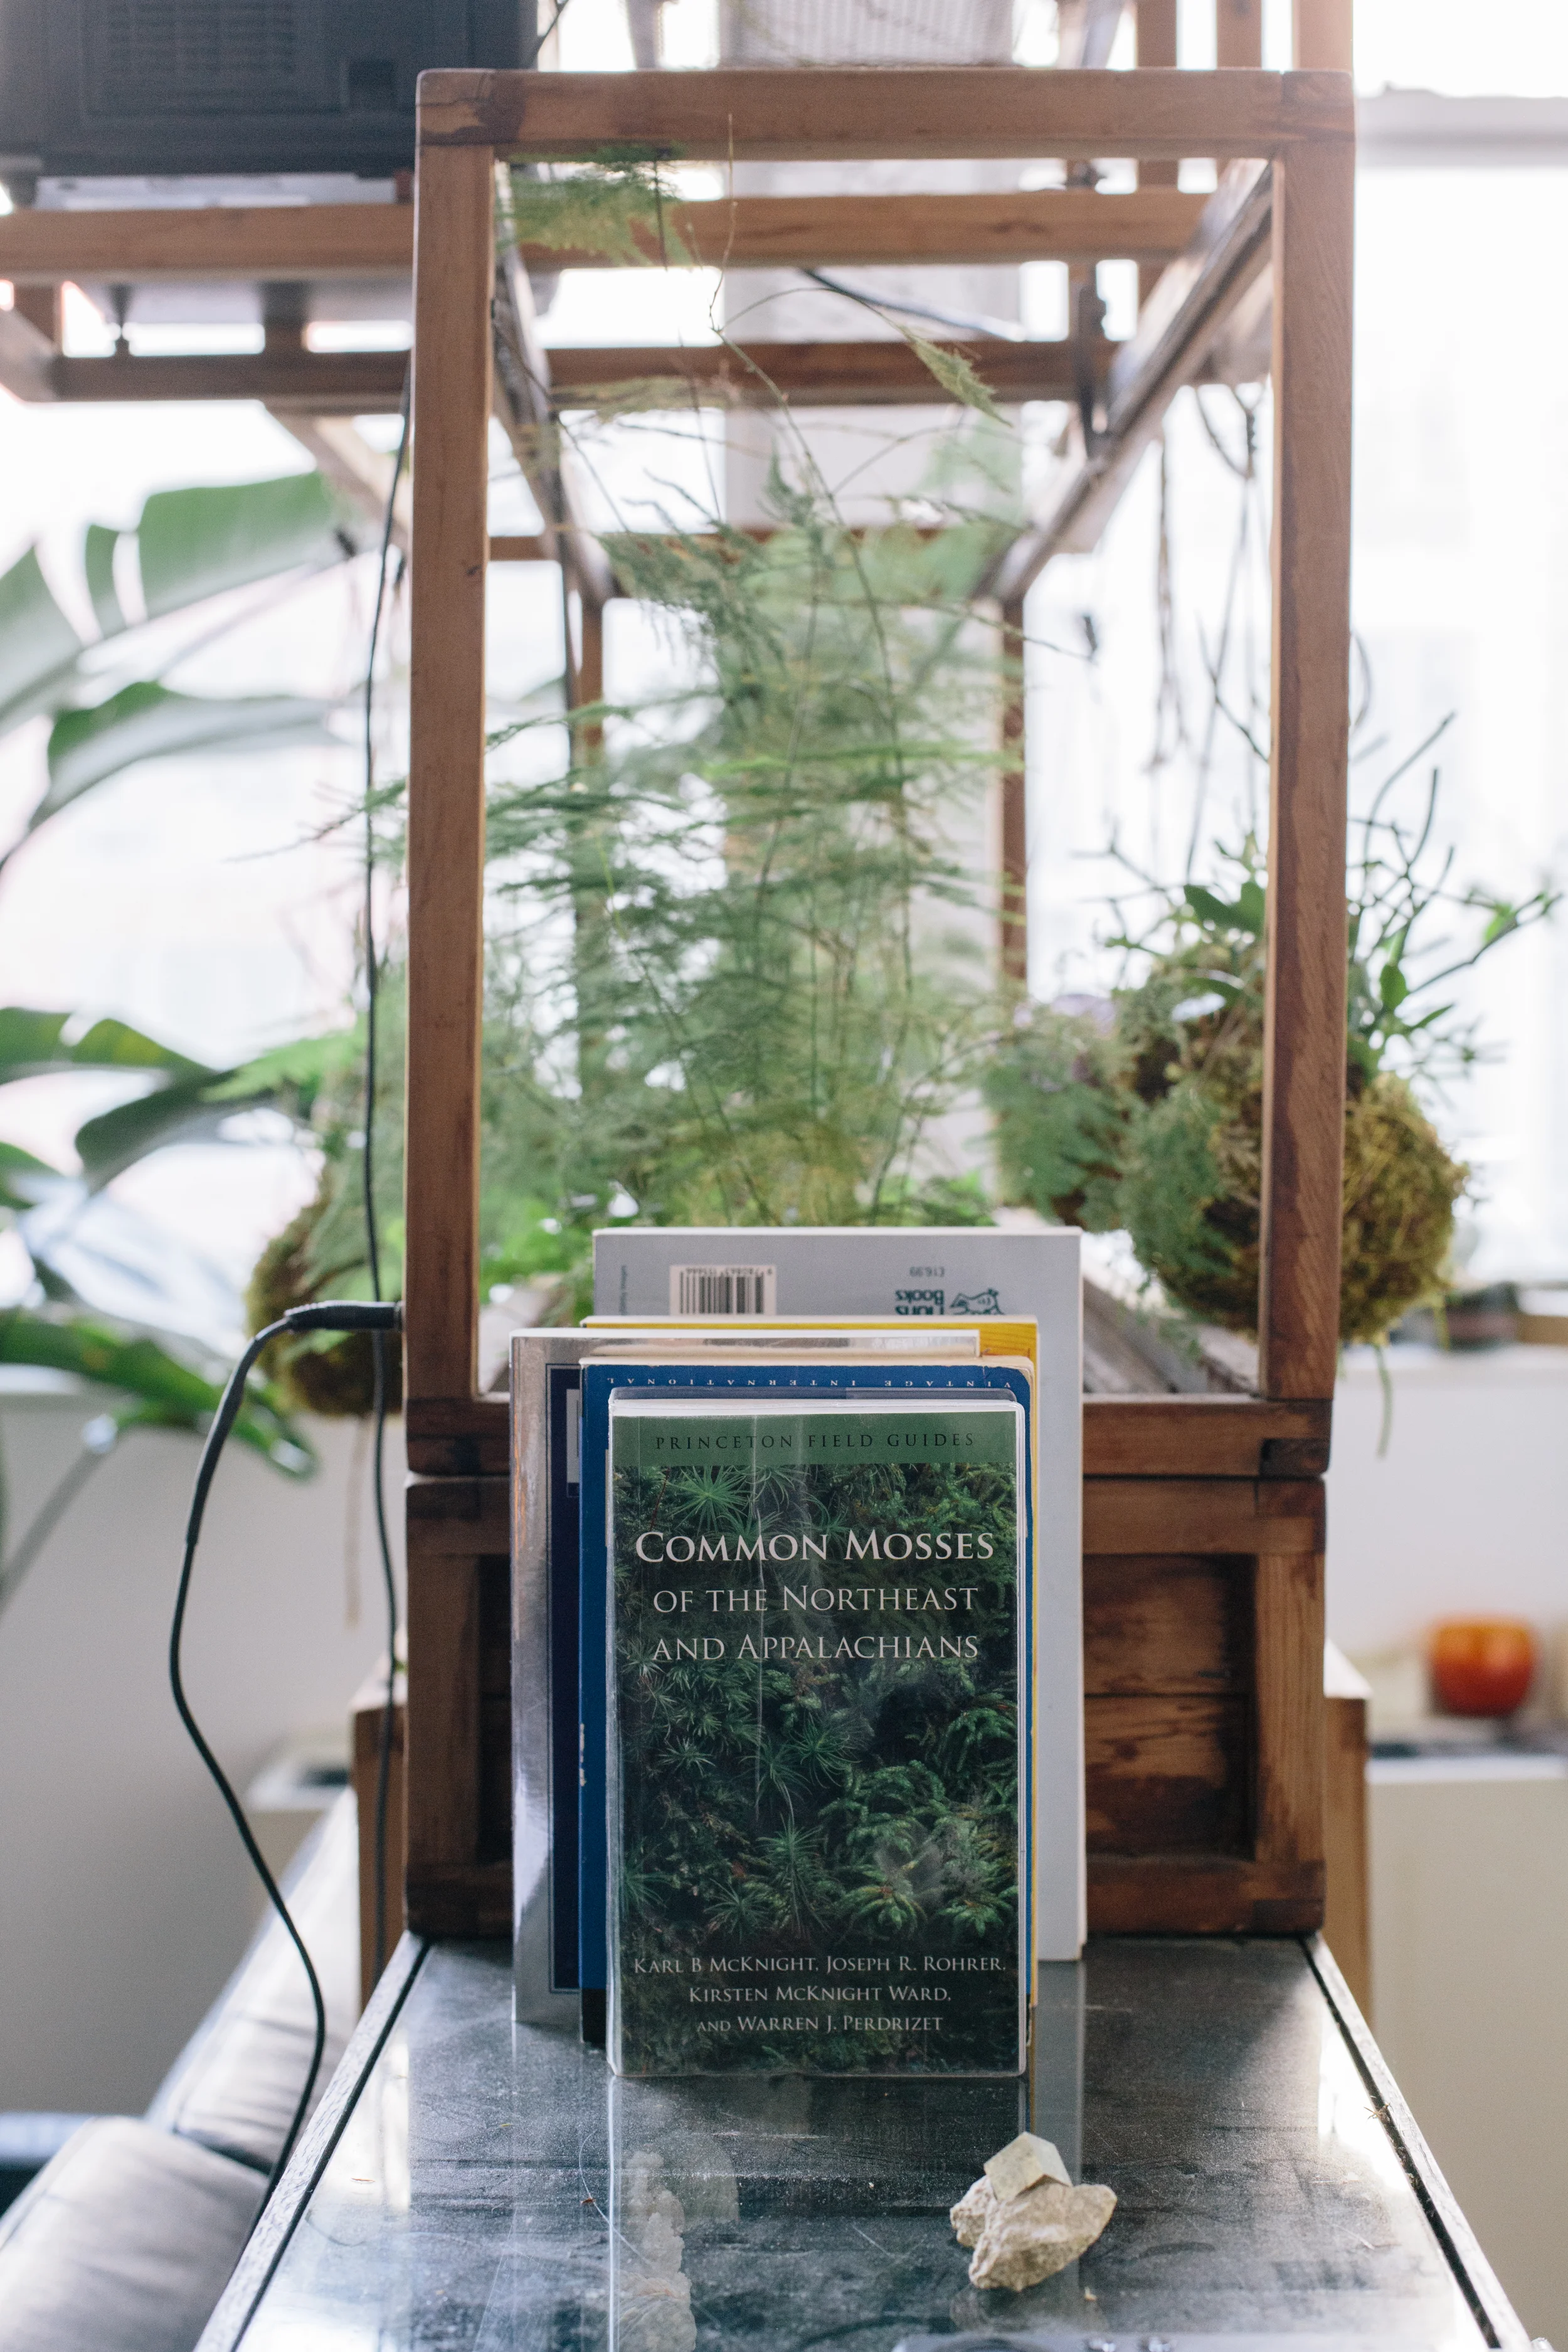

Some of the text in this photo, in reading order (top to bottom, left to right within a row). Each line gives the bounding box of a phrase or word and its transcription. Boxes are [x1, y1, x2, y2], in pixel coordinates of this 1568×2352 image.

[895, 1289, 945, 1306] Books
[607, 1377, 1011, 1389] VINTAGE INTERNATIONAL
[655, 1433, 974, 1450] PRINCETON FIELD GUIDES
[635, 1528, 994, 1563] COMMON MOSSES
[653, 1584, 979, 1613] OF THE NORTHEAST
[651, 1633, 979, 1661] AND APPALACHIANS
[633, 1957, 684, 1974] KARL
[826, 1955, 890, 1975] JOSEPH
[899, 1955, 917, 1971] R.
[689, 1987, 768, 2003] KIRSTEN
[696, 2015, 944, 2034] AND WARREN J. PERDRIZET
